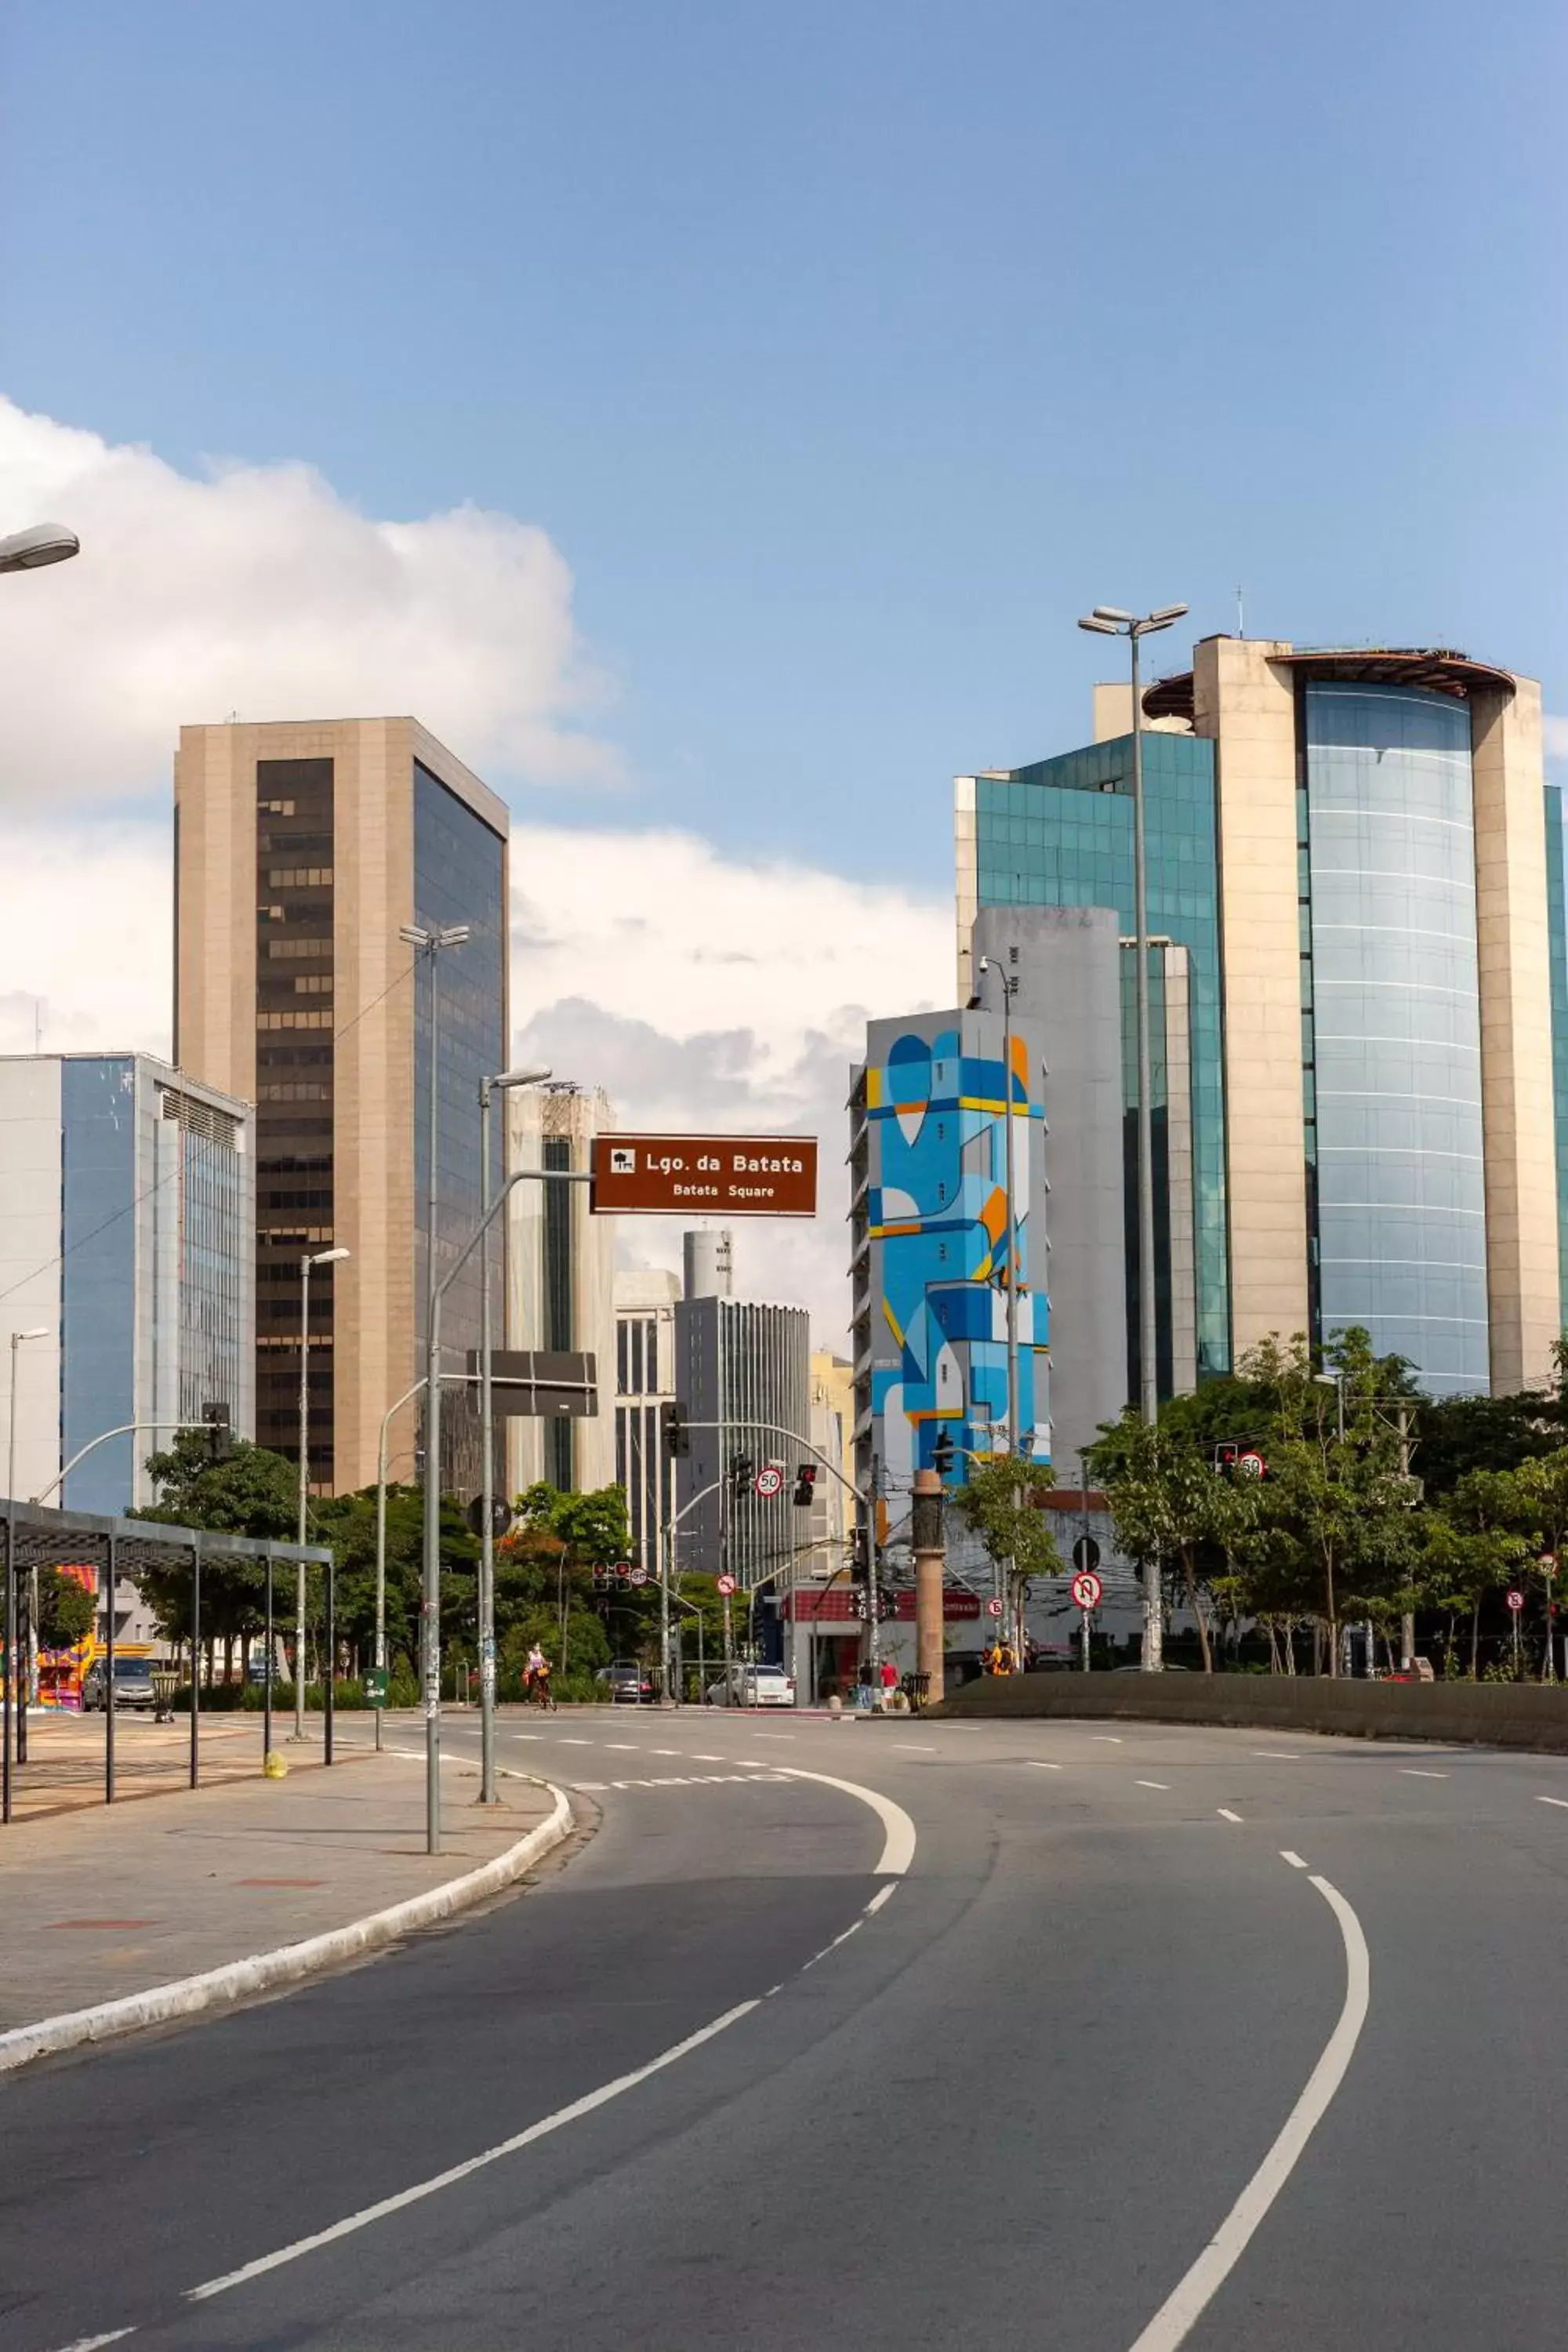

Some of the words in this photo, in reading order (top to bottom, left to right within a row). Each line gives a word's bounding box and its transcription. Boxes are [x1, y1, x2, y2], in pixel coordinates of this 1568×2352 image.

[647, 1153, 690, 1175] Lgo.
[697, 1156, 720, 1171] da
[733, 1155, 803, 1173] Batata
[673, 1183, 719, 1196] Batata
[728, 1185, 775, 1199] Square
[760, 1475, 778, 1487] 50
